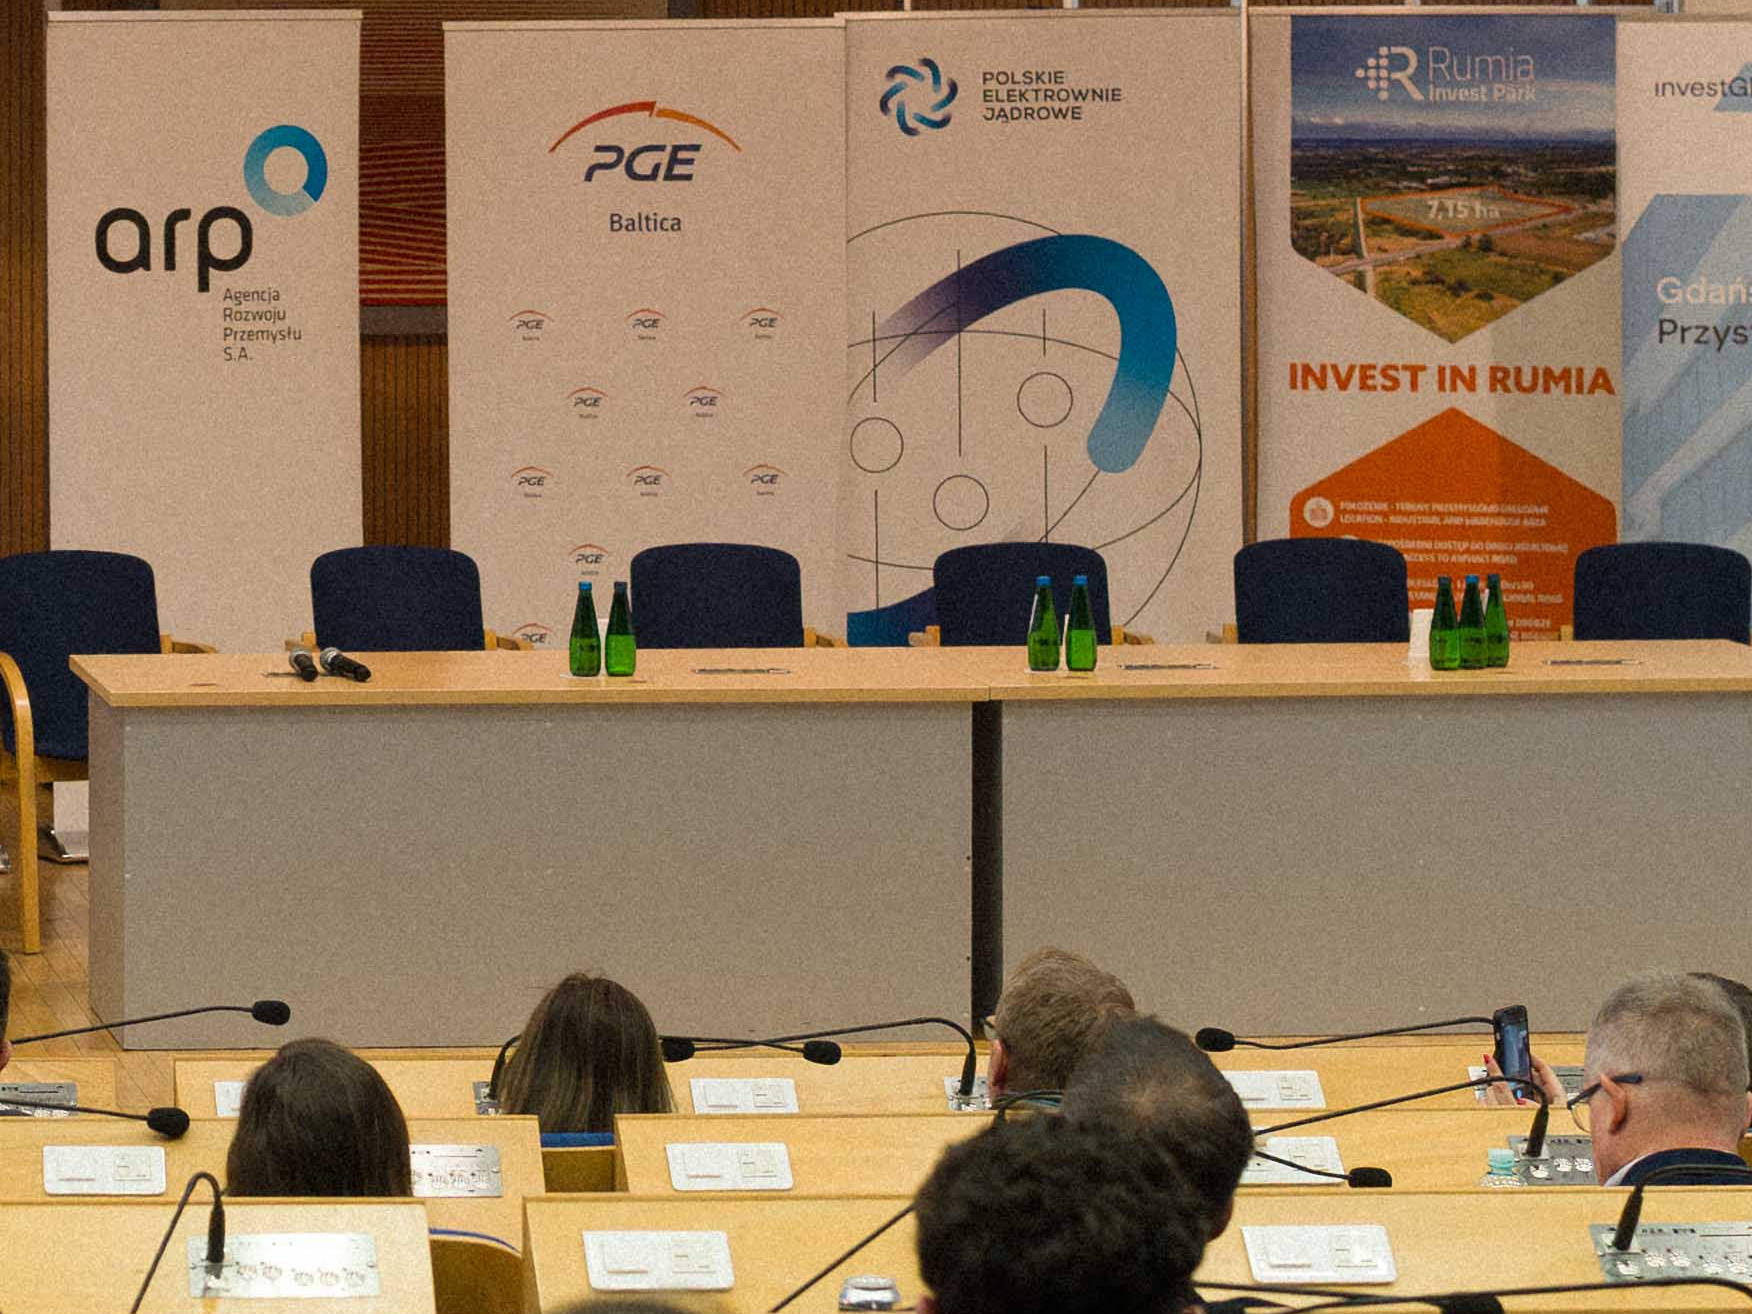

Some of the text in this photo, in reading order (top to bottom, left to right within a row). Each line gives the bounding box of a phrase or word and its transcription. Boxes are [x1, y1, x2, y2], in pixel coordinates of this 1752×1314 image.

[1428, 45, 1535, 81] Rumia
[982, 71, 1065, 86] POLSKIE
[982, 88, 1122, 103] ELEKTROWNIE
[1429, 84, 1488, 102] Invest
[982, 105, 1083, 124] JĄDROWE
[584, 144, 702, 182] PGE
[609, 212, 682, 234] Baltica
[95, 206, 253, 293] arp
[223, 288, 281, 306] Agencja
[223, 307, 287, 323] Rozwoju
[223, 327, 303, 344] Przemysłu
[223, 347, 253, 362] S.A.
[1289, 362, 1616, 396] INVEST IN RUMIA
